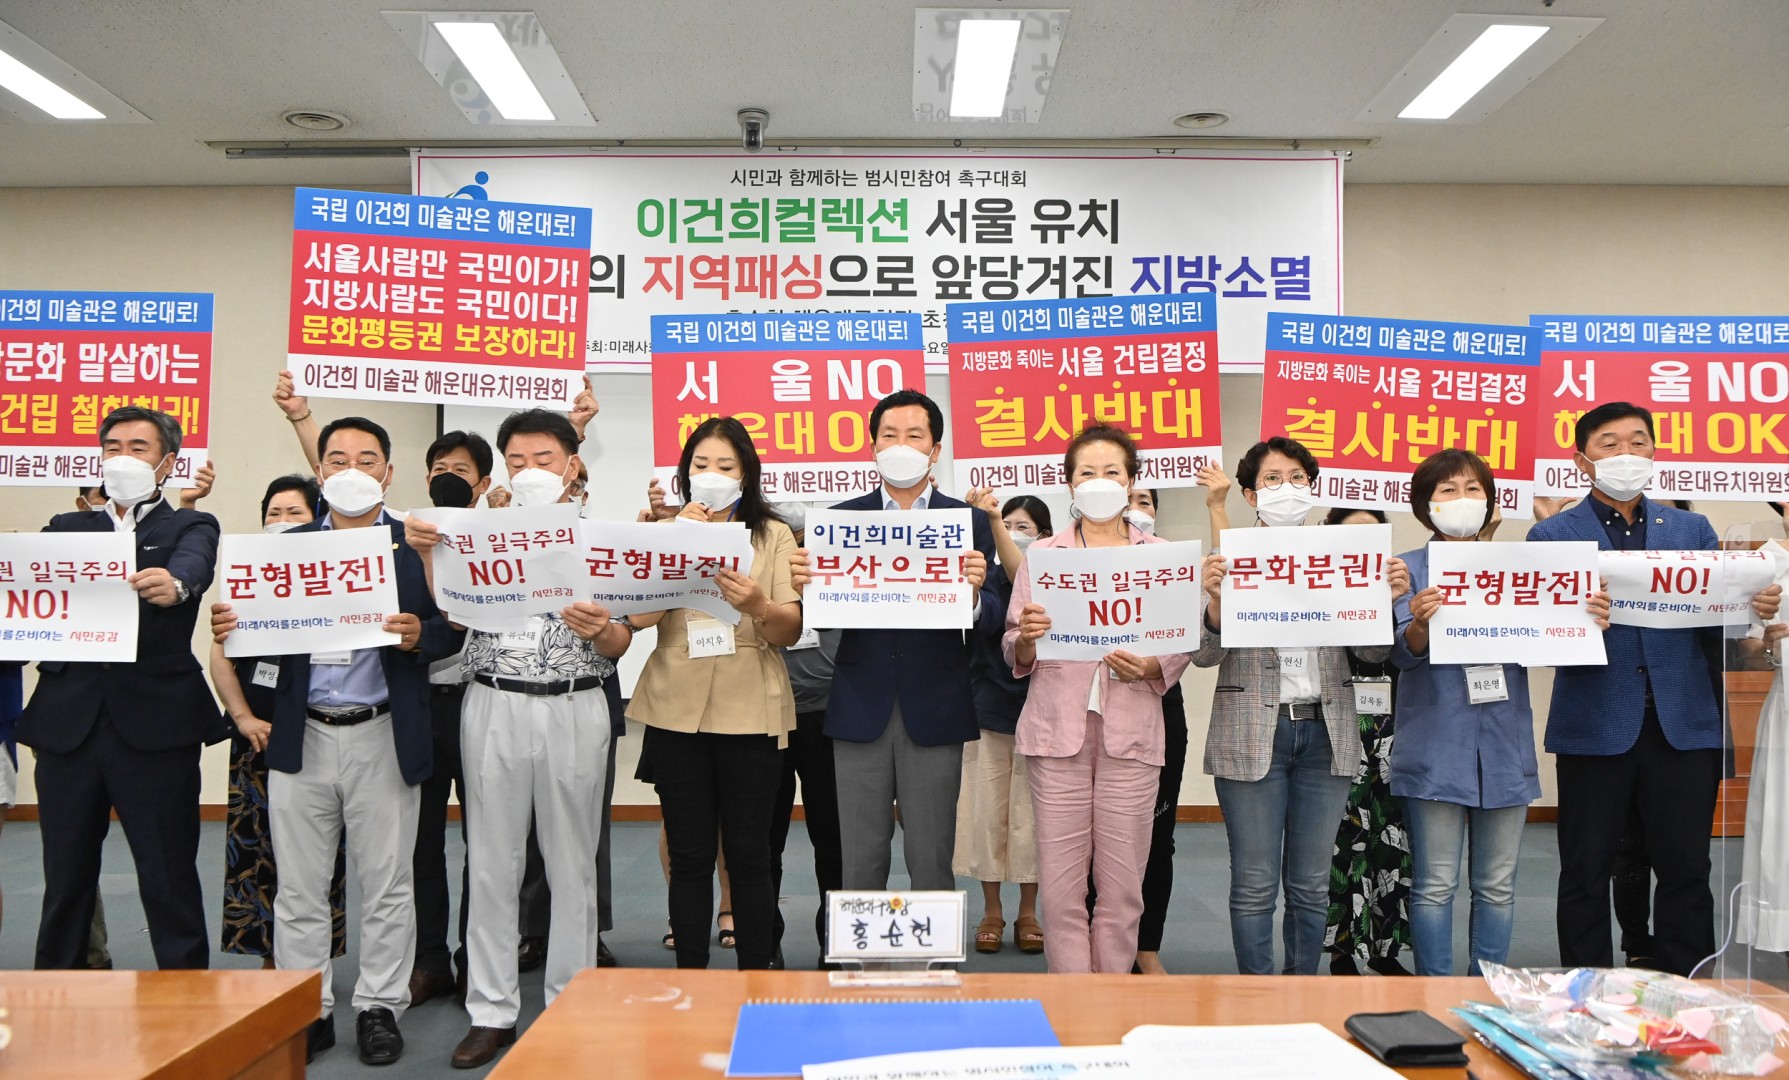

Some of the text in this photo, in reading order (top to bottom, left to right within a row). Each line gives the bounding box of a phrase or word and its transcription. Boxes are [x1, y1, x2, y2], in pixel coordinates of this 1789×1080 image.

[730, 169, 1027, 188] 시민과 함께하는 범시민참여 촉구대회
[311, 196, 576, 237] 국립 이건희 미술관은 해운대로!
[637, 197, 1119, 244] 이건희컬렉션 서울 유치
[304, 242, 579, 288] 서울사람만 국민이가!
[642, 254, 917, 300] 지역패싱으로
[932, 255, 1114, 300] 앞당겨진
[1130, 255, 1311, 300] 지방소멸
[49, 299, 117, 322] 미술관은
[124, 301, 198, 323] 해운대로!
[303, 279, 577, 323] 지방사람도 국민이다!
[666, 319, 908, 344] 국립 이건희 미술관은 해운대로!
[962, 302, 1202, 334] 국립 이건희 미술관은 해운대로!
[301, 315, 576, 359] 문화평등권 보장하라!
[1282, 321, 1526, 356] 국립 이건희 미술관은 해운대로!
[1545, 322, 1577, 342] 국립
[1585, 322, 1635, 343] 이건희
[1644, 322, 1712, 344] 미술관은
[0, 342, 200, 384] 문화 말살하는
[962, 341, 1207, 377] 지방문화 죽이는 서울 건립결정
[305, 363, 568, 402] 이건희 미술관 해운대유치위원회
[1277, 360, 1527, 405] 지방문화 죽이는 서울 건립결정
[1708, 361, 1789, 403] NO
[0, 394, 58, 434] 건립
[975, 380, 1203, 448] 결사반대
[1284, 400, 1517, 470] 결사반대
[1707, 412, 1789, 454] OK
[0, 455, 48, 478] 미술관
[970, 465, 1018, 488] 이건희
[1329, 477, 1378, 501] 미술관
[488, 527, 575, 553] 일극주의
[814, 524, 965, 549] 이건희미술관
[30, 561, 127, 583] 일극주의
[226, 556, 386, 600] 균형발전!
[468, 559, 526, 586] NO!
[811, 555, 966, 588] 부산으로!
[1037, 565, 1195, 593] 수도권 일극주의
[1229, 553, 1383, 590] 문화분권!
[1650, 566, 1710, 595] NO!
[443, 587, 573, 604] 미래사회를준비하는 시민공감
[593, 591, 684, 602] 미래사회를준비하는
[819, 592, 957, 603] 미래사회를준비하는 시민공감
[1437, 570, 1592, 606] 균형발전!
[5, 589, 68, 620] NO!
[1088, 597, 1142, 626] NO!
[1237, 609, 1378, 622] 미래사회를준비하는 시민공감
[70, 630, 118, 642] 시민공감
[237, 612, 383, 631] 미래사회를준비하는 시민공감
[1446, 626, 1587, 638] 미래사회를준비하는 시민공감
[696, 635, 724, 648] 이지후
[1050, 628, 1186, 646] 미래사회를준비하는 시민공감
